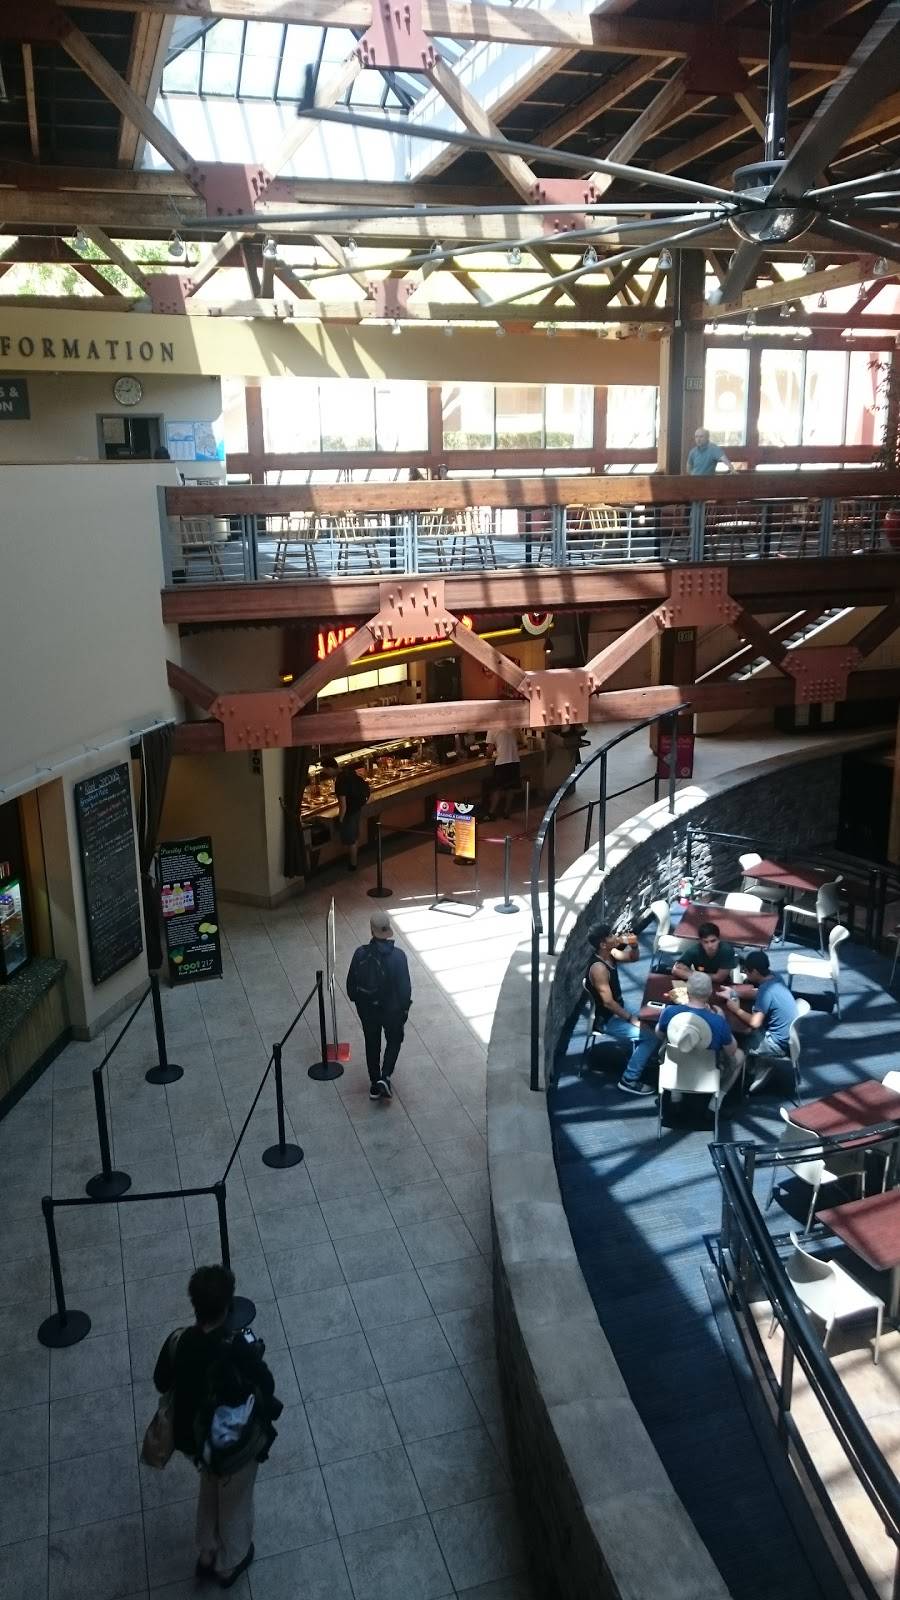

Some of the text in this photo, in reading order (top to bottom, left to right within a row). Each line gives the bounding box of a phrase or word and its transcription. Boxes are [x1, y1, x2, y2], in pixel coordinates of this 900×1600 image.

[9, 386, 19, 398] &
[679, 631, 692, 641] EXIT
[178, 960, 200, 972] root
